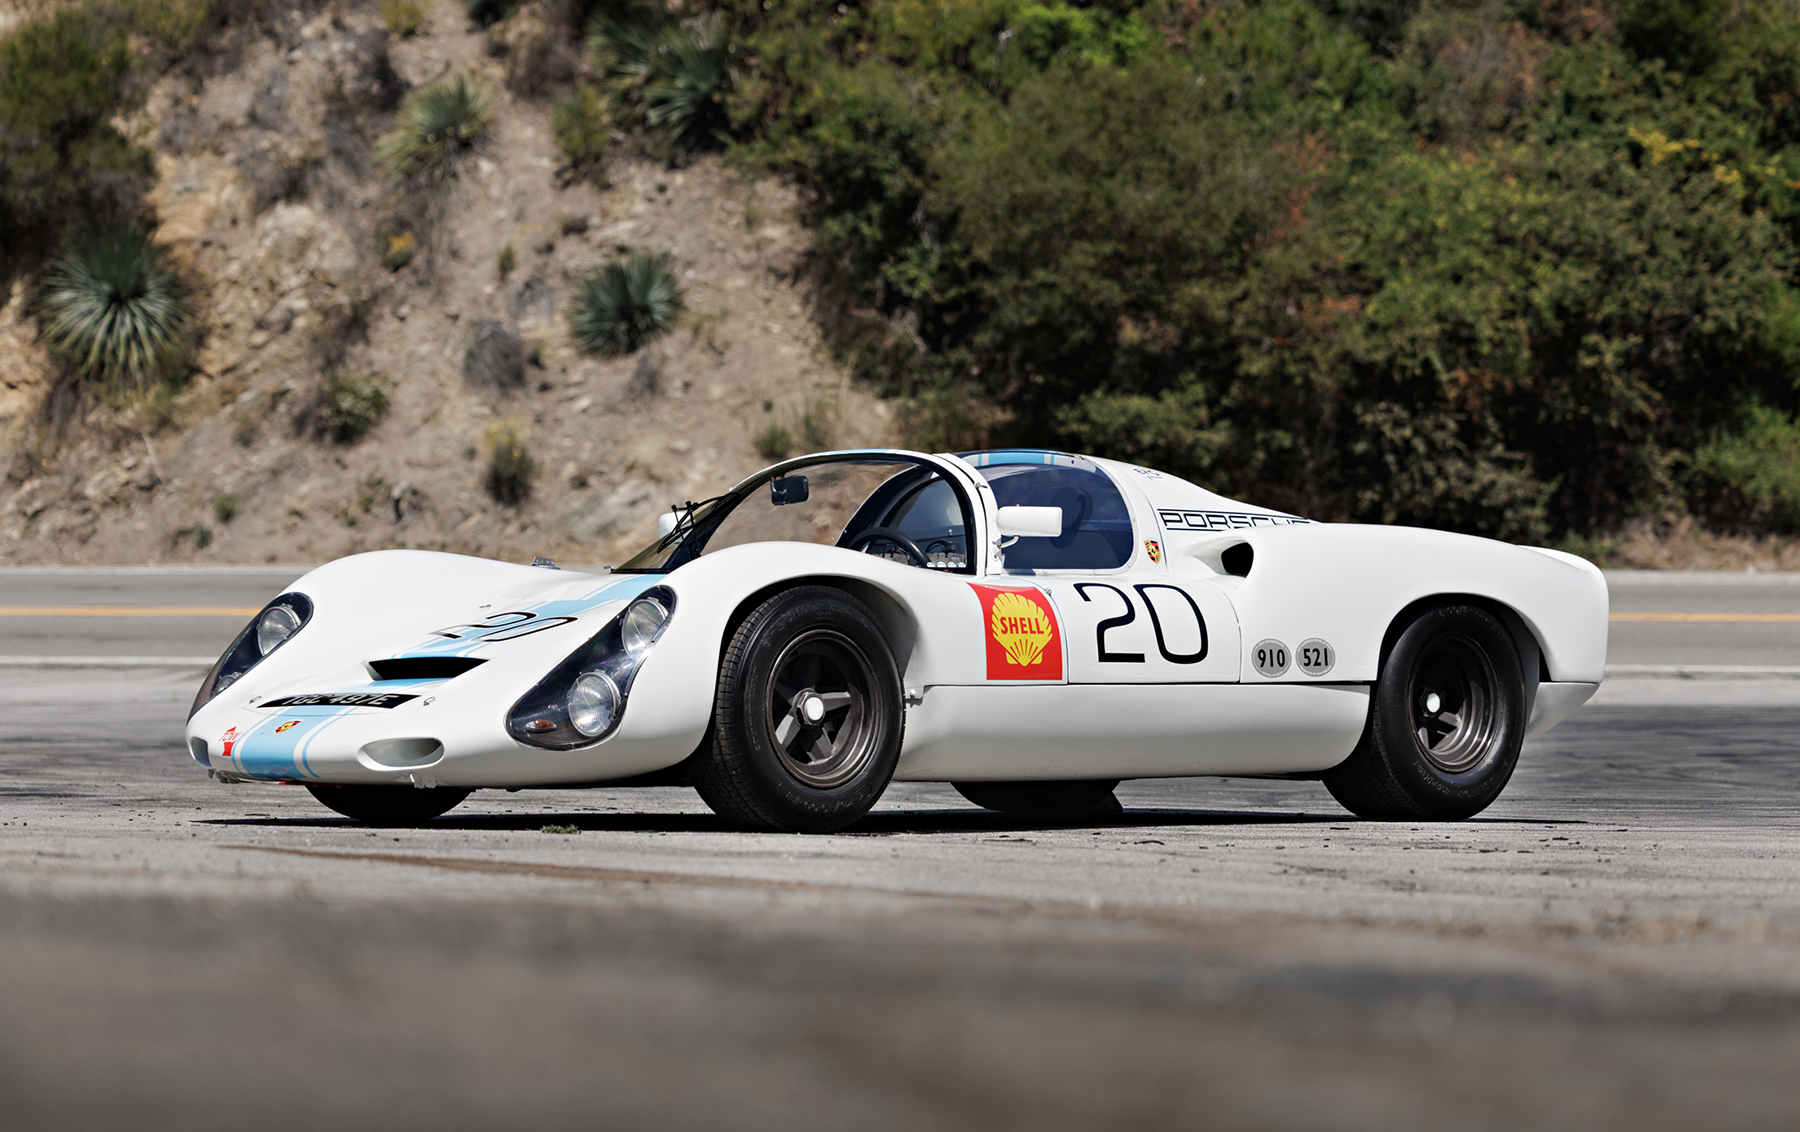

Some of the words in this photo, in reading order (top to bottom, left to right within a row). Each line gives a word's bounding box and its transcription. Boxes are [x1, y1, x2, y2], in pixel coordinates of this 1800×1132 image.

[1159, 512, 1311, 529] PORSC
[427, 611, 579, 643] 20
[1000, 616, 1045, 635] SHELL
[1073, 582, 1209, 665] 20
[1257, 648, 1286, 668] 910
[1303, 647, 1329, 667] 521
[329, 693, 400, 706] 497E
[218, 731, 244, 743] TOW
